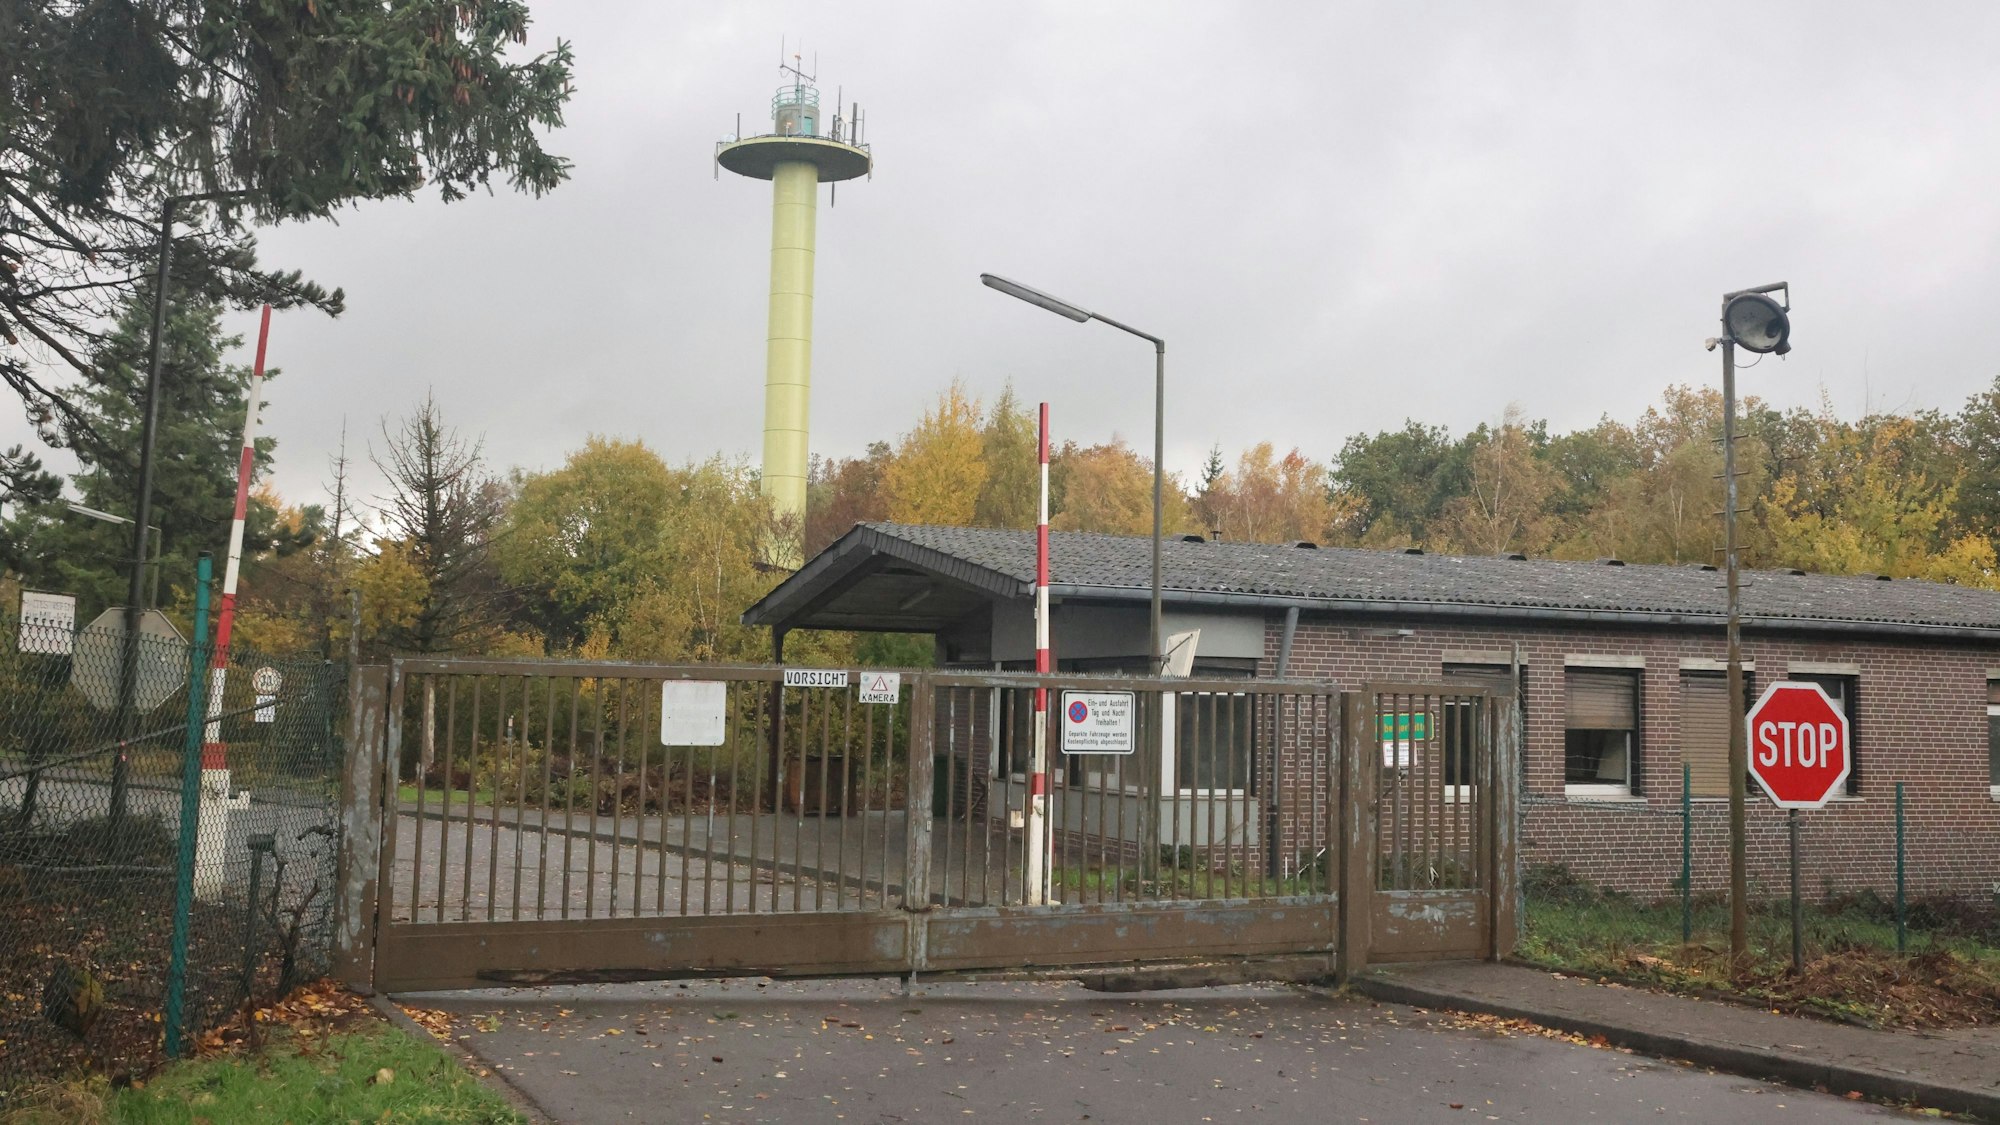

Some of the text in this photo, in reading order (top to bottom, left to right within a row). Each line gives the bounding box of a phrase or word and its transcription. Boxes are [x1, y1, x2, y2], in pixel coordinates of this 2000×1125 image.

[786, 671, 846, 685] VORSICHT
[862, 693, 895, 702] KAMERA
[1088, 699, 1129, 707] Ein- und Ausfahrt
[1112, 709, 1125, 717] Nacht
[1758, 720, 1837, 768] STOP
